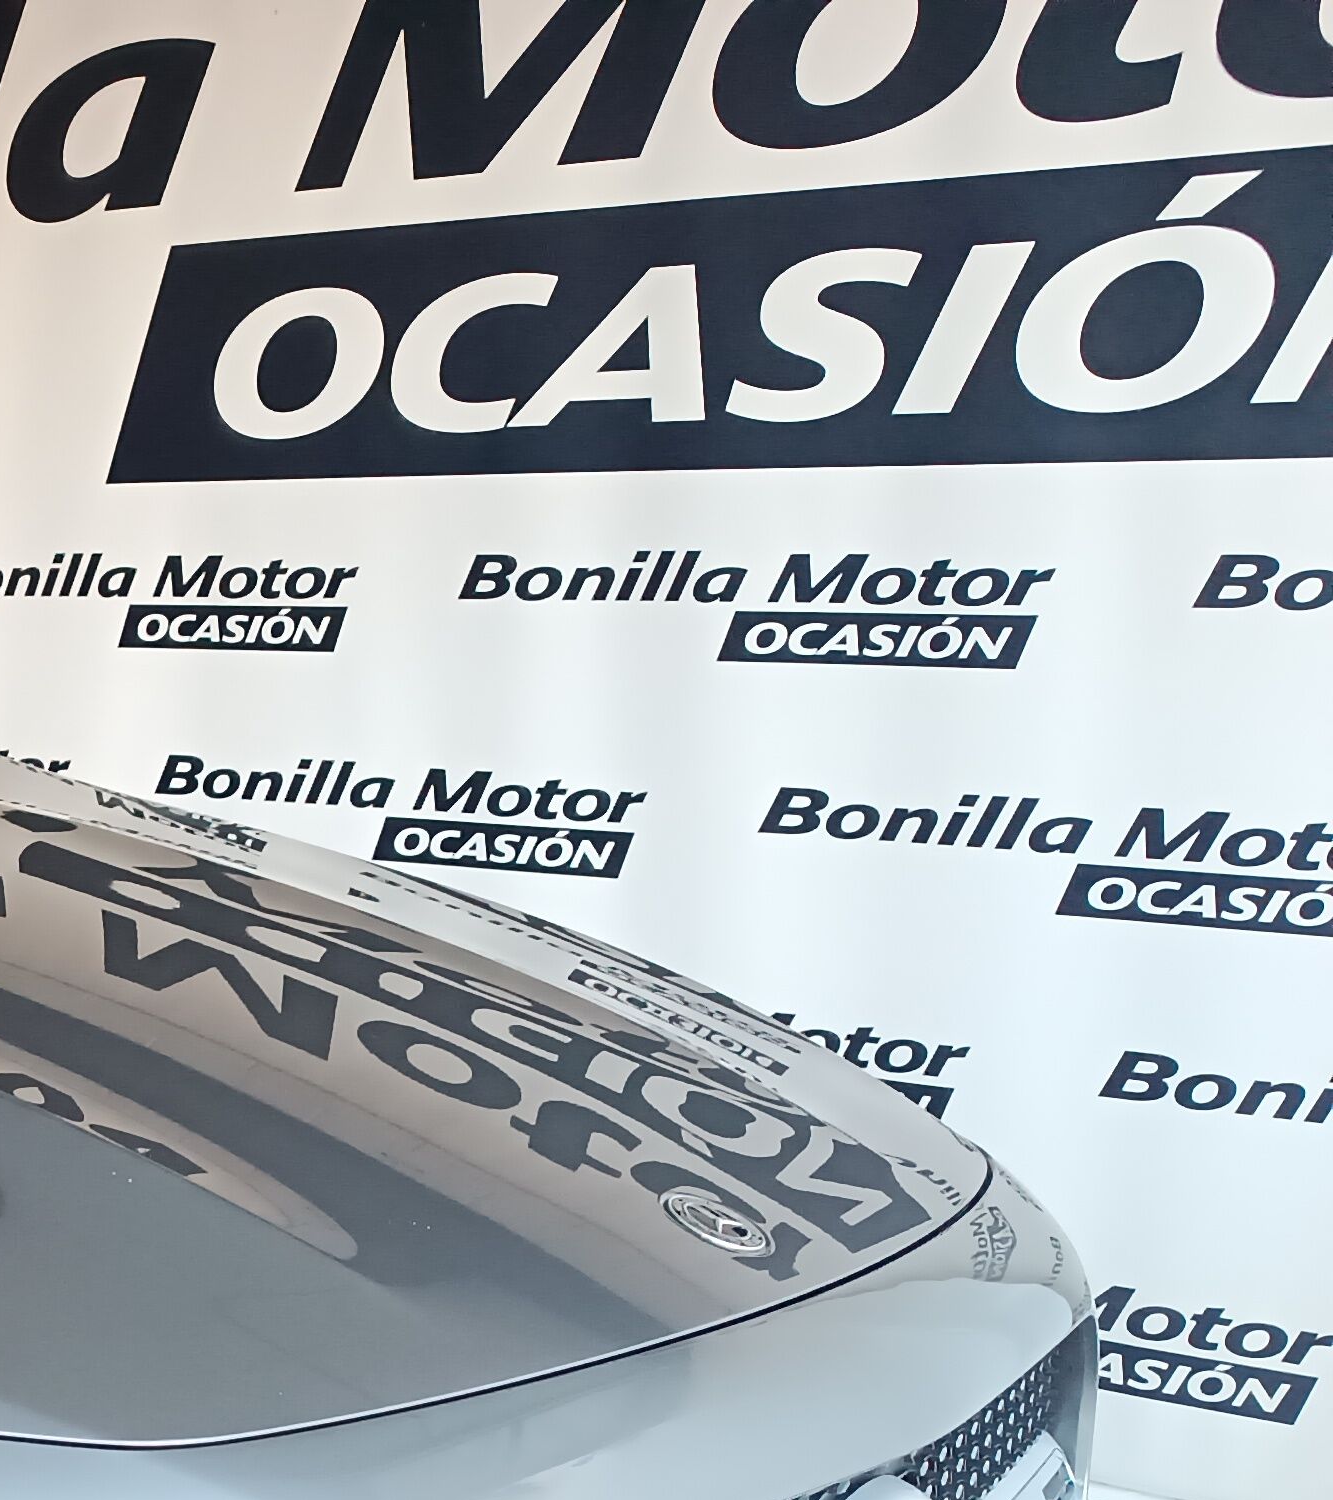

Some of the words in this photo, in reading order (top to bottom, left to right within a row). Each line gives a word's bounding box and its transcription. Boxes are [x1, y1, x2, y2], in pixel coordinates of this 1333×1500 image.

[153, 554, 359, 599] Motor
[458, 551, 748, 603] Bonilla
[768, 554, 1055, 606] Motor
[137, 608, 330, 645] OCASIÓN
[744, 617, 1014, 659] OCASIÓN
[155, 755, 395, 808] Bonilla
[413, 768, 647, 823] Motor
[394, 828, 615, 870] OCASIÓN
[758, 787, 1093, 853] Bonilla
[1114, 807, 1333, 871] Mot
